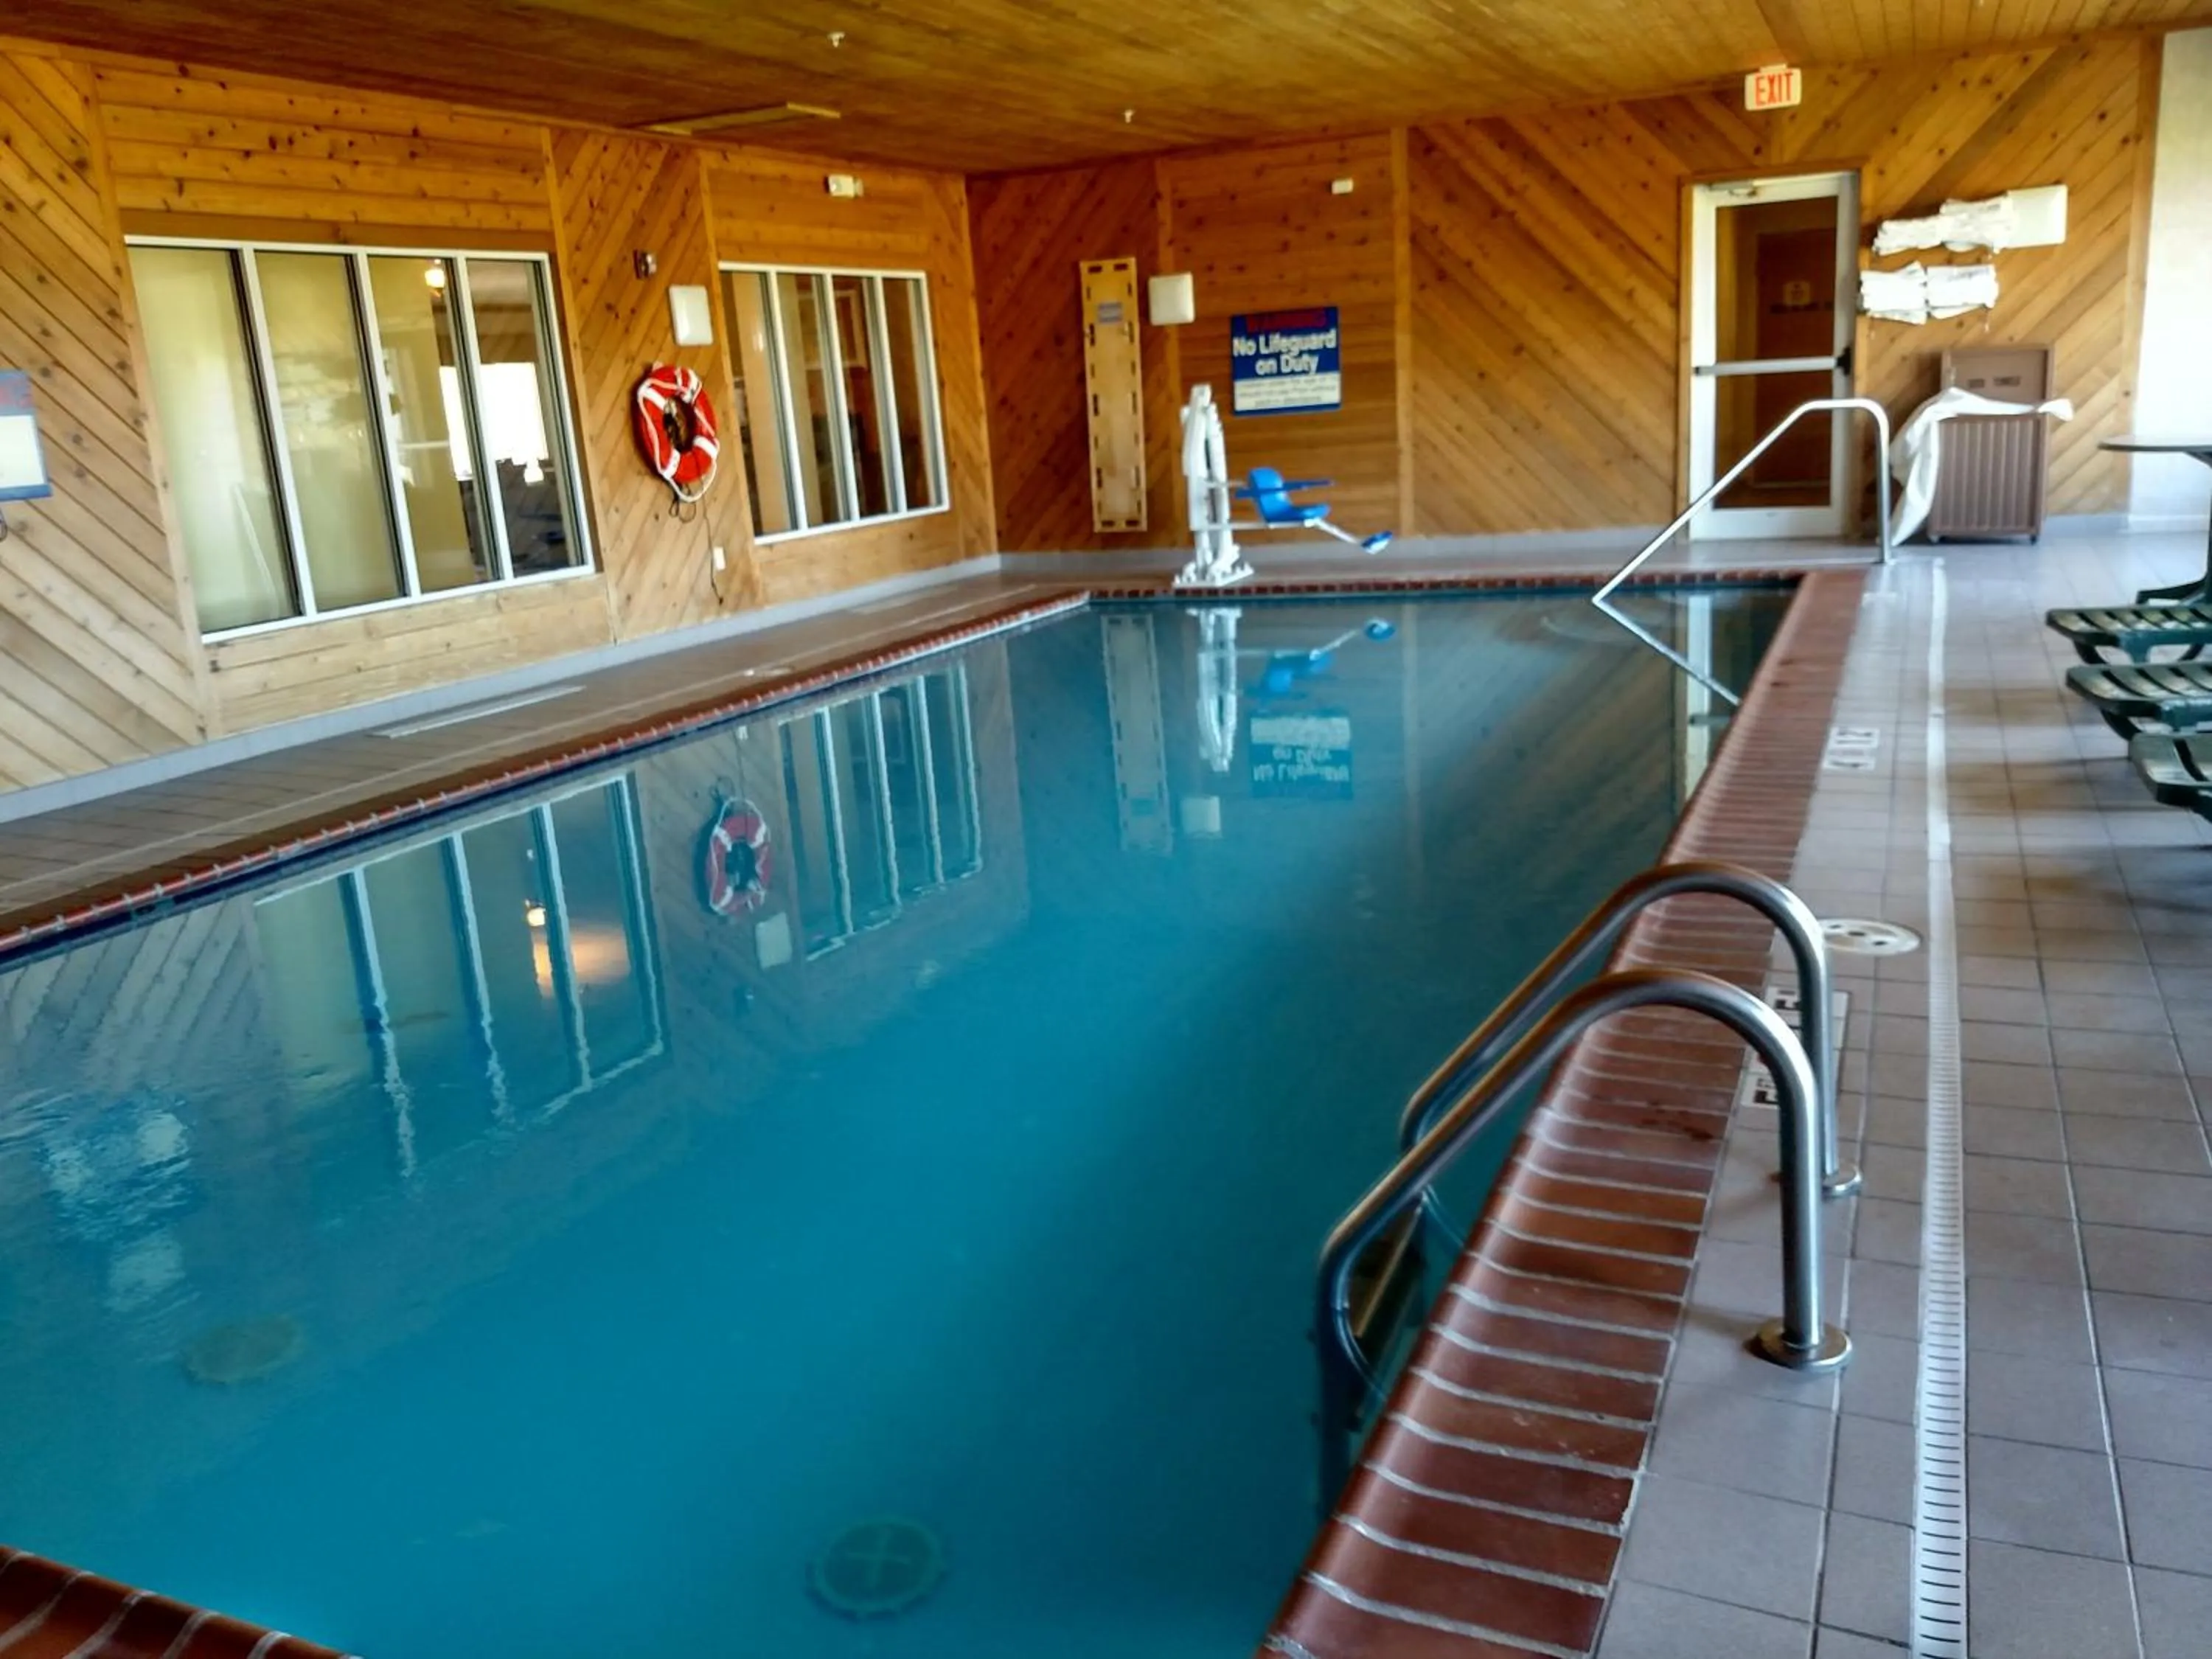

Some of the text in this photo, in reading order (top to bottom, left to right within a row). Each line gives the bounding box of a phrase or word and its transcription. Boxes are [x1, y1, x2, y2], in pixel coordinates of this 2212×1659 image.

[1756, 72, 1793, 106] EXIT
[1233, 328, 1337, 357] No Lifeguard
[1256, 353, 1319, 375] on Duty
